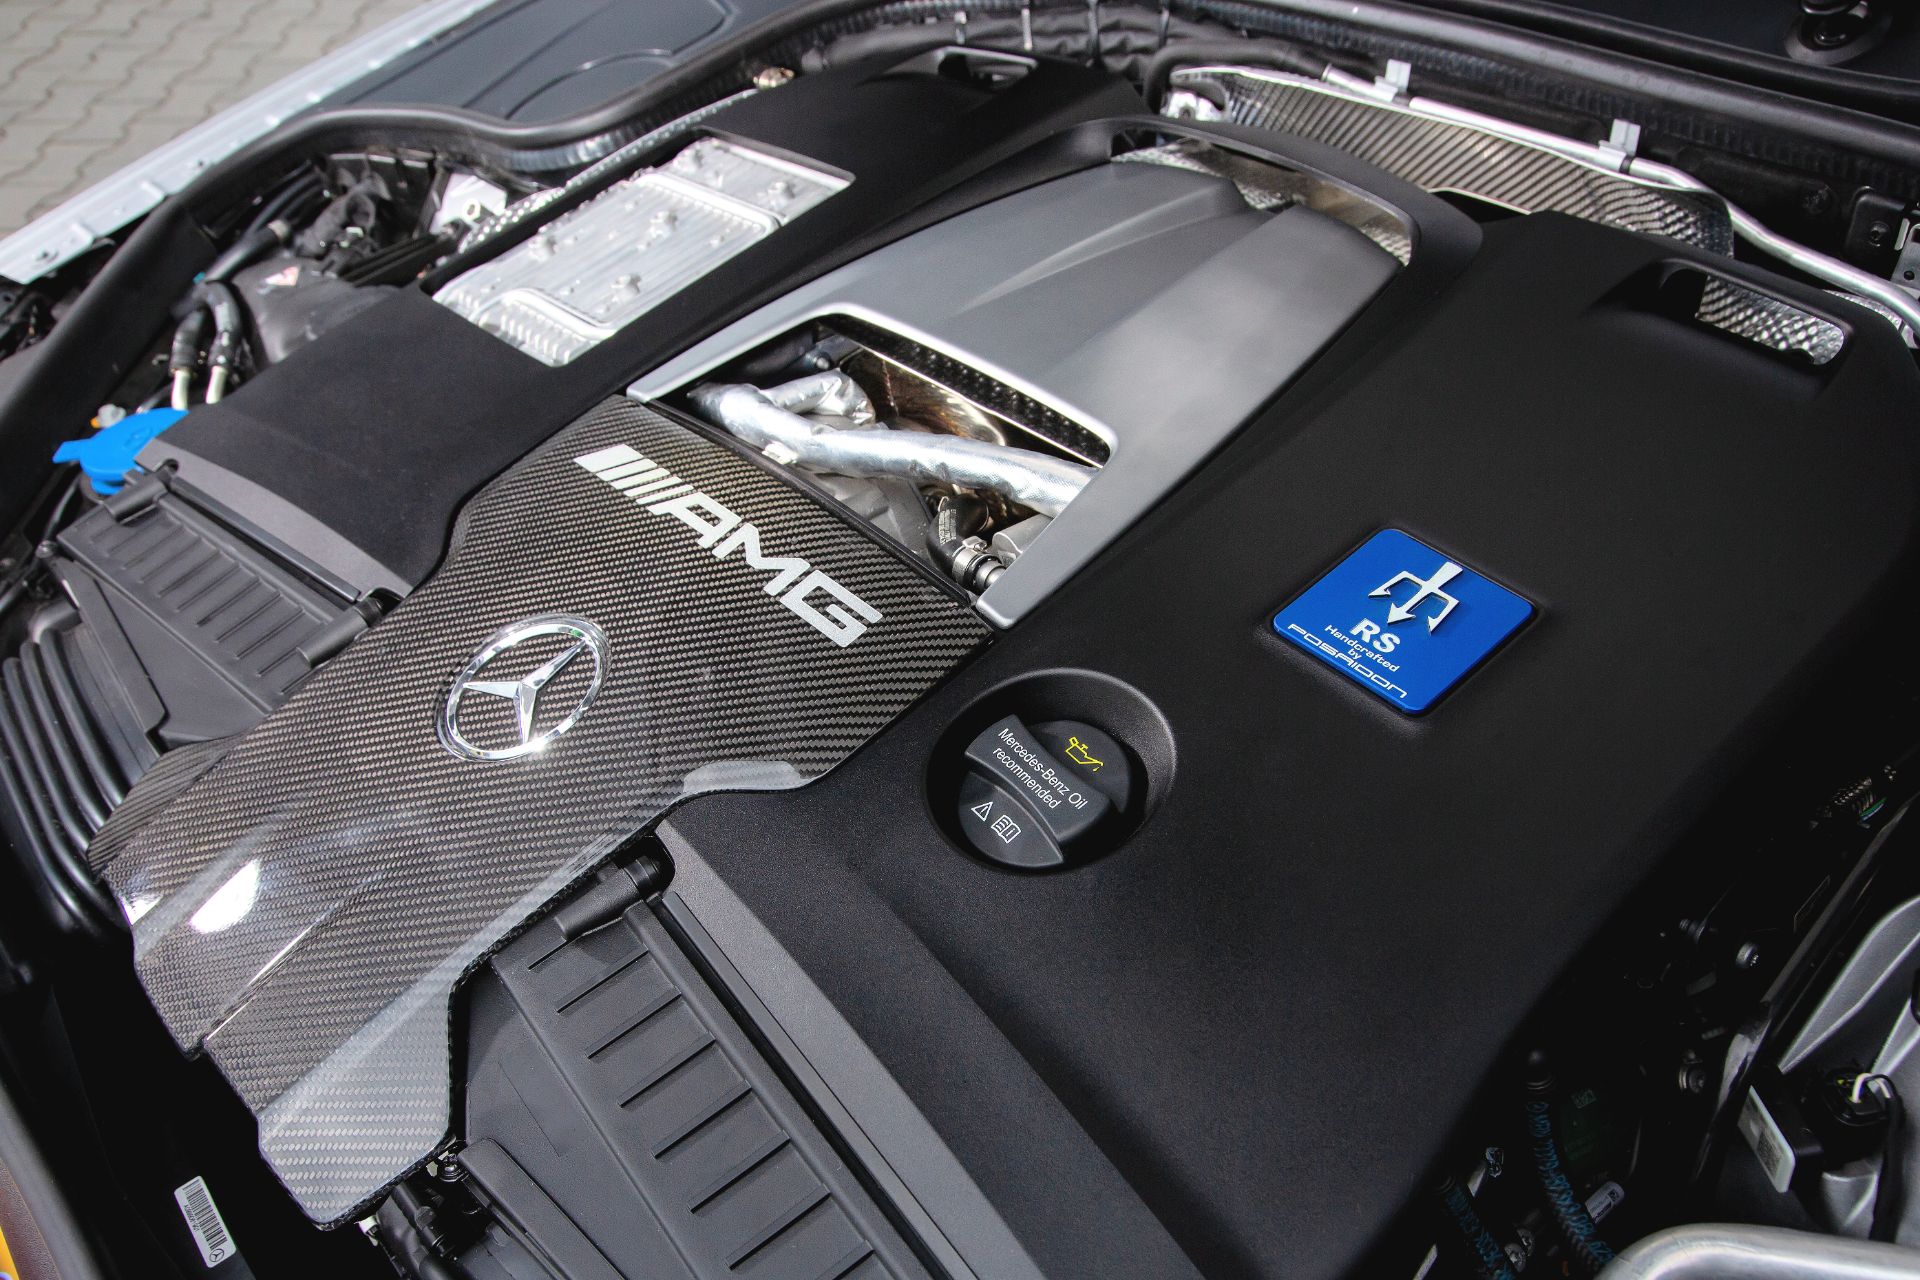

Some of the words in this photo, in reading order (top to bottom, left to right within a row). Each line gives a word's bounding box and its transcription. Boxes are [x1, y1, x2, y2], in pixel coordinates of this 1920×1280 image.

[647, 492, 883, 648] AMG
[1324, 624, 1400, 672] Handcrafted
[1347, 648, 1362, 661] by
[1349, 617, 1401, 653] RS
[992, 747, 1061, 809] recommended
[998, 728, 1070, 796] Mercedes-Benz
[1068, 792, 1088, 810] Oil
